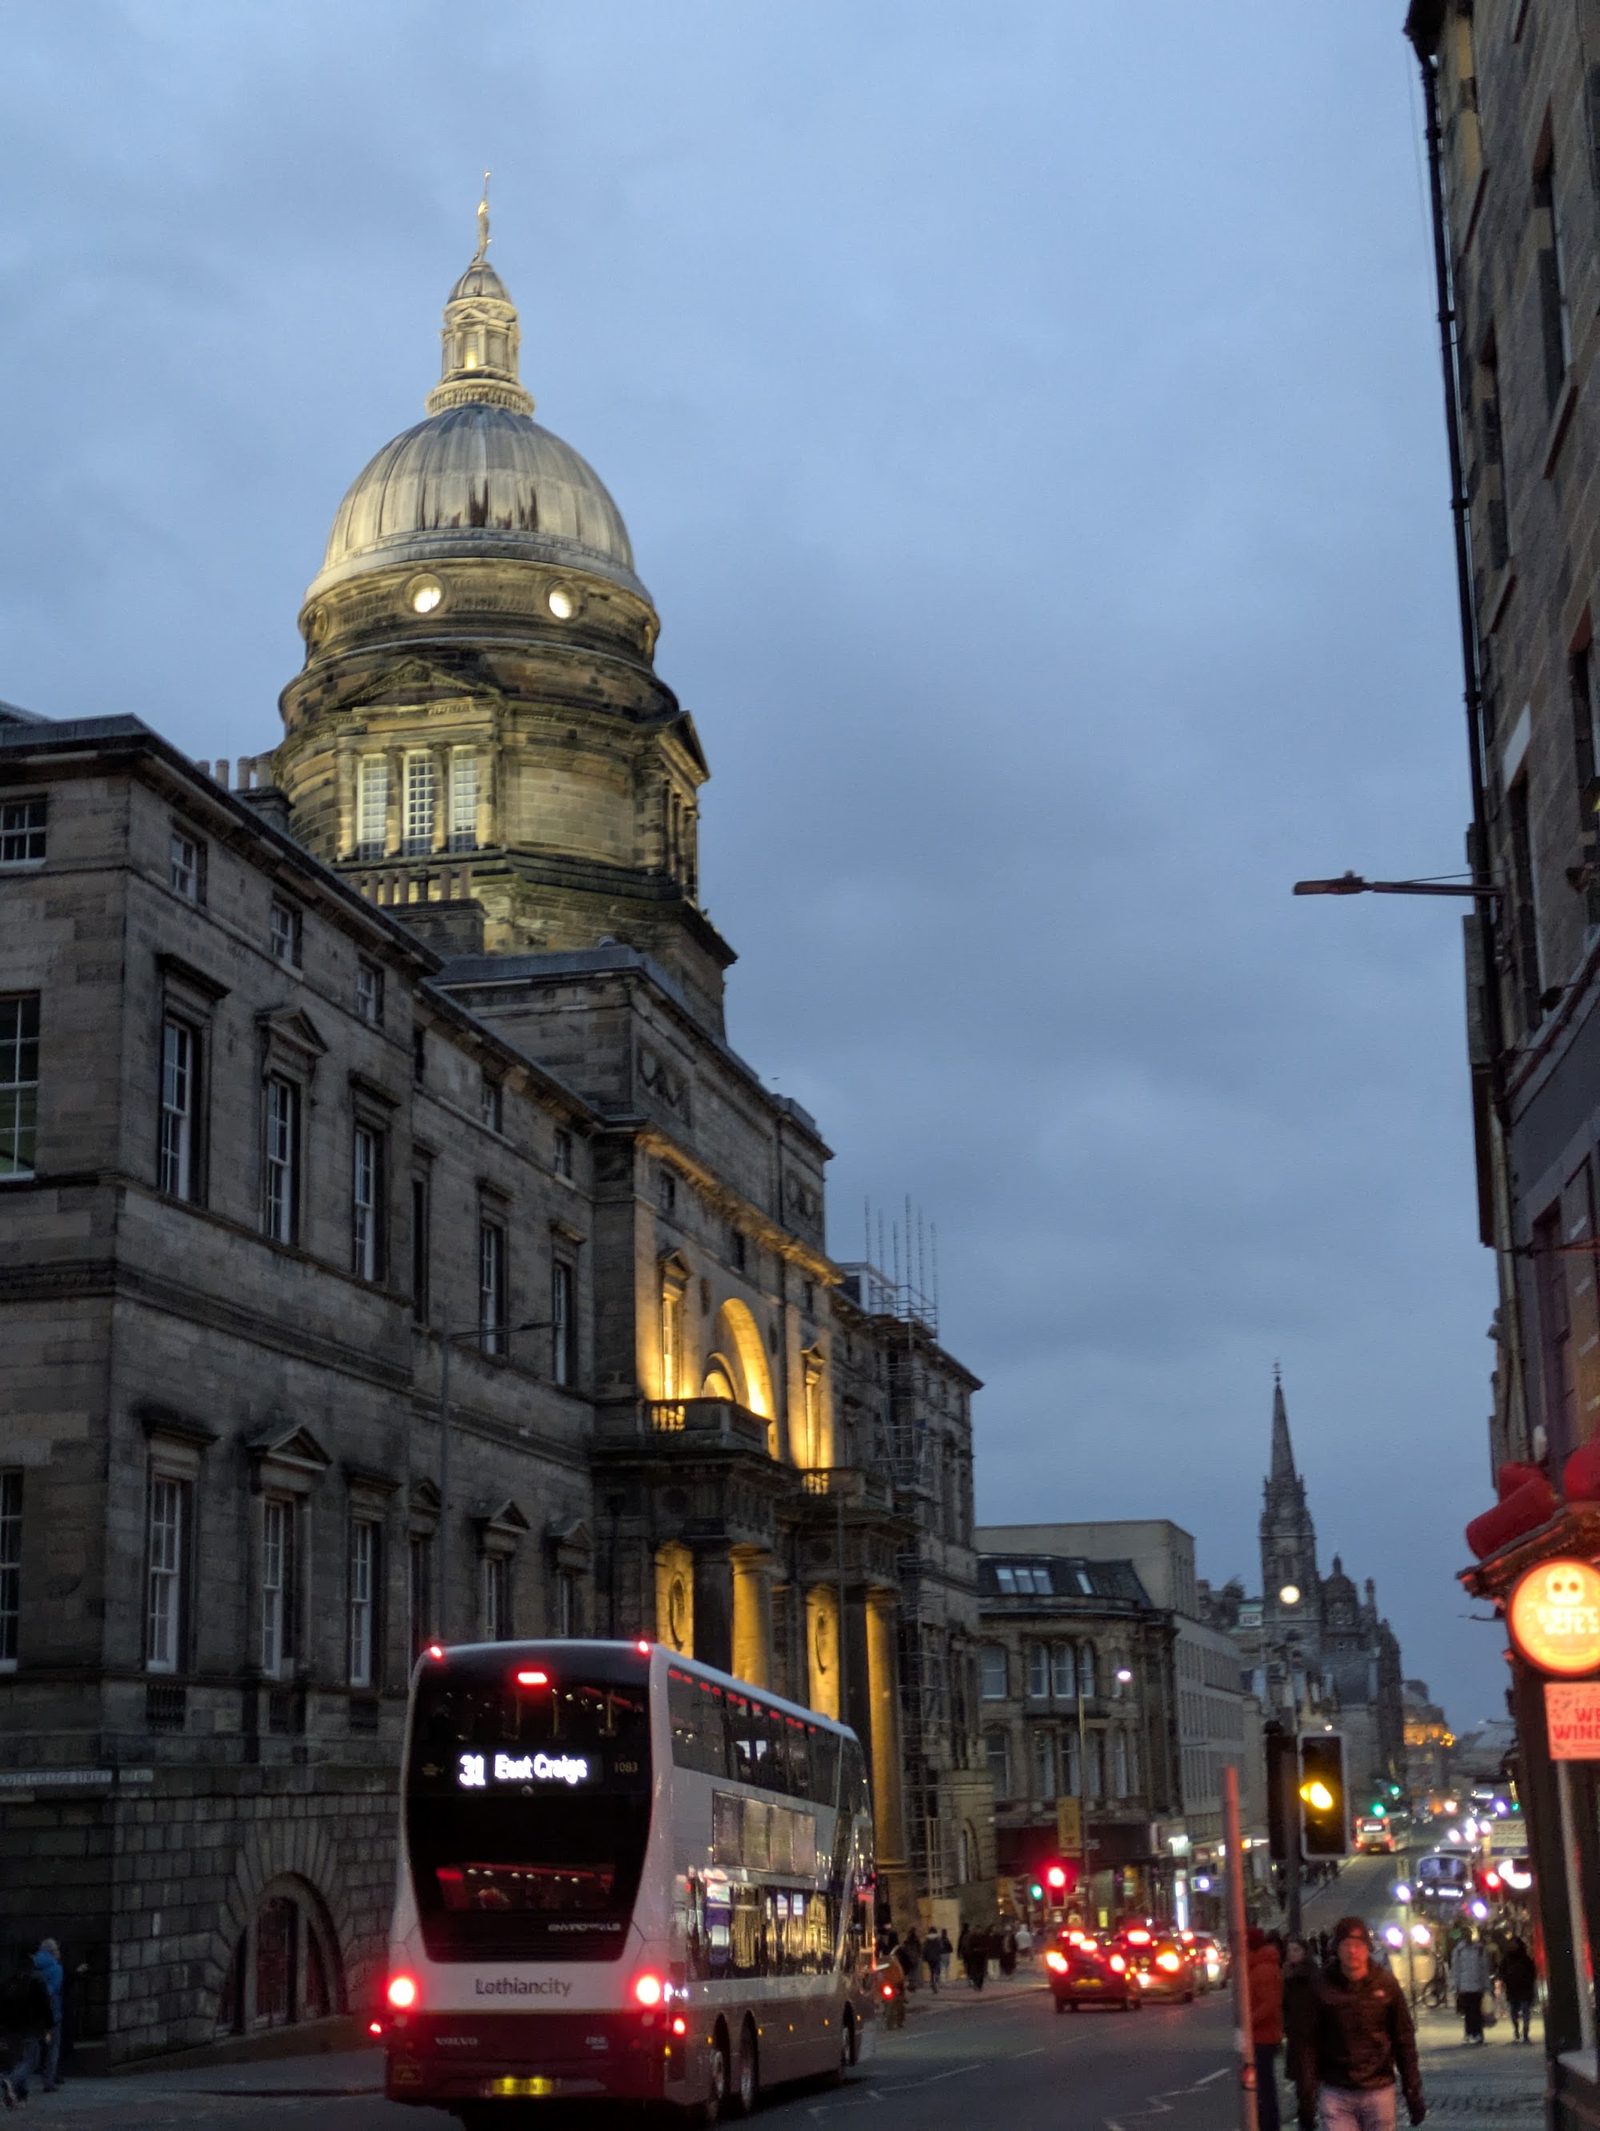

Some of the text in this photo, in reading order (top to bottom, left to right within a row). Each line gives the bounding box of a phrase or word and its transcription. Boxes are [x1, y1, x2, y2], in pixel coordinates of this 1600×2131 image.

[459, 1753, 588, 1786] 31 East Craigs
[613, 1761, 639, 1774] 1083
[475, 1977, 573, 1997] Lothiancity
[434, 2037, 479, 2046] VOLVO
